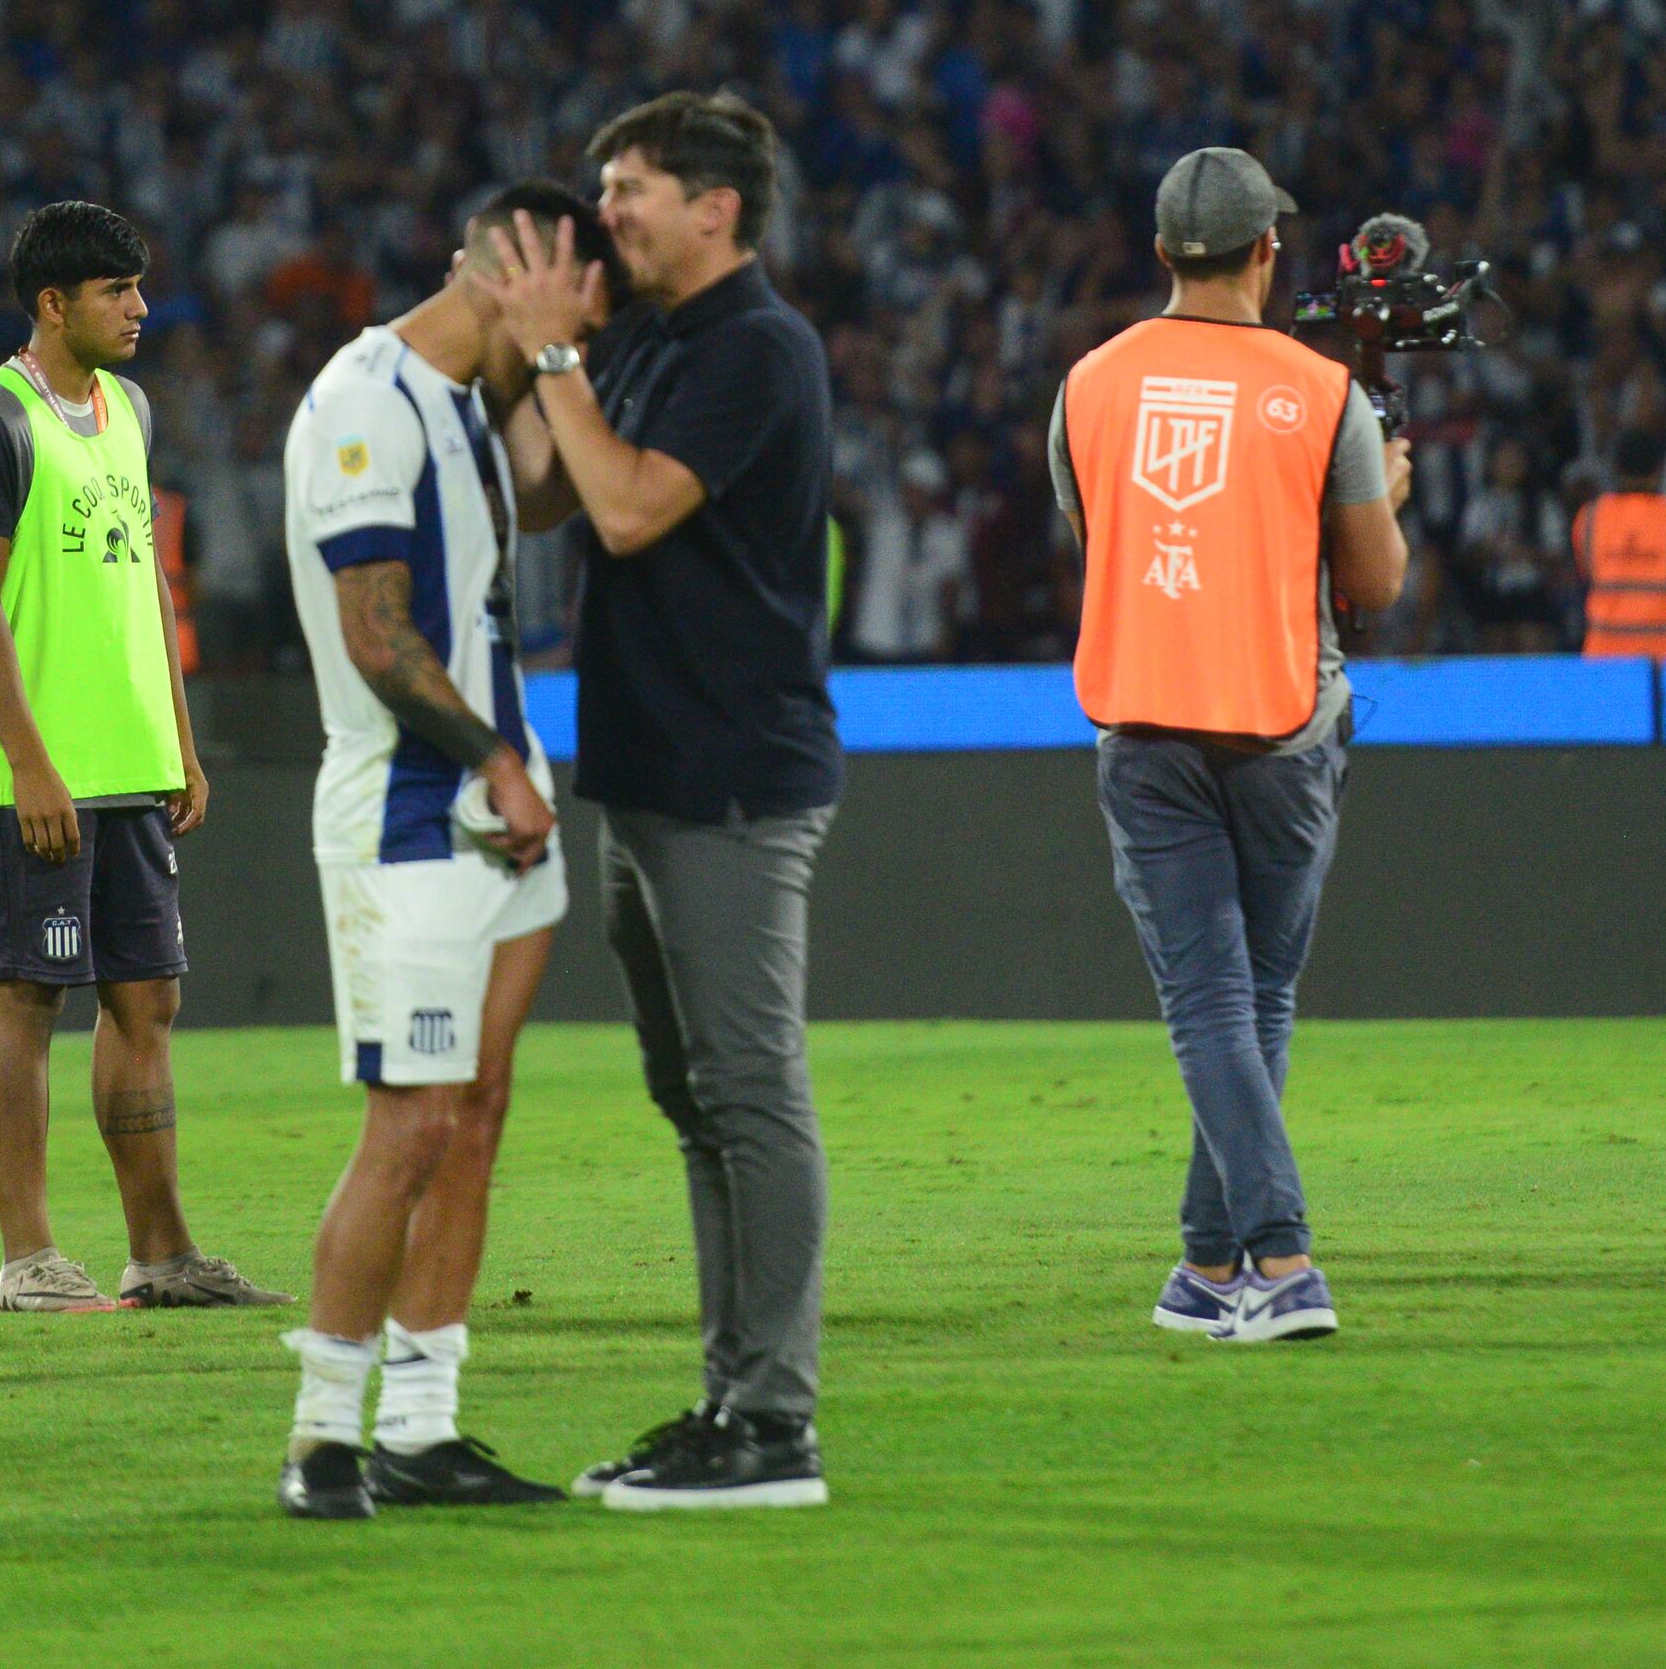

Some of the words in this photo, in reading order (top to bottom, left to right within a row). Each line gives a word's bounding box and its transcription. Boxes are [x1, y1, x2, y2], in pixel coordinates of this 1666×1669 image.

[1265, 397, 1299, 422] 63
[62, 523, 86, 553] LE
[1142, 538, 1202, 599] AFA
